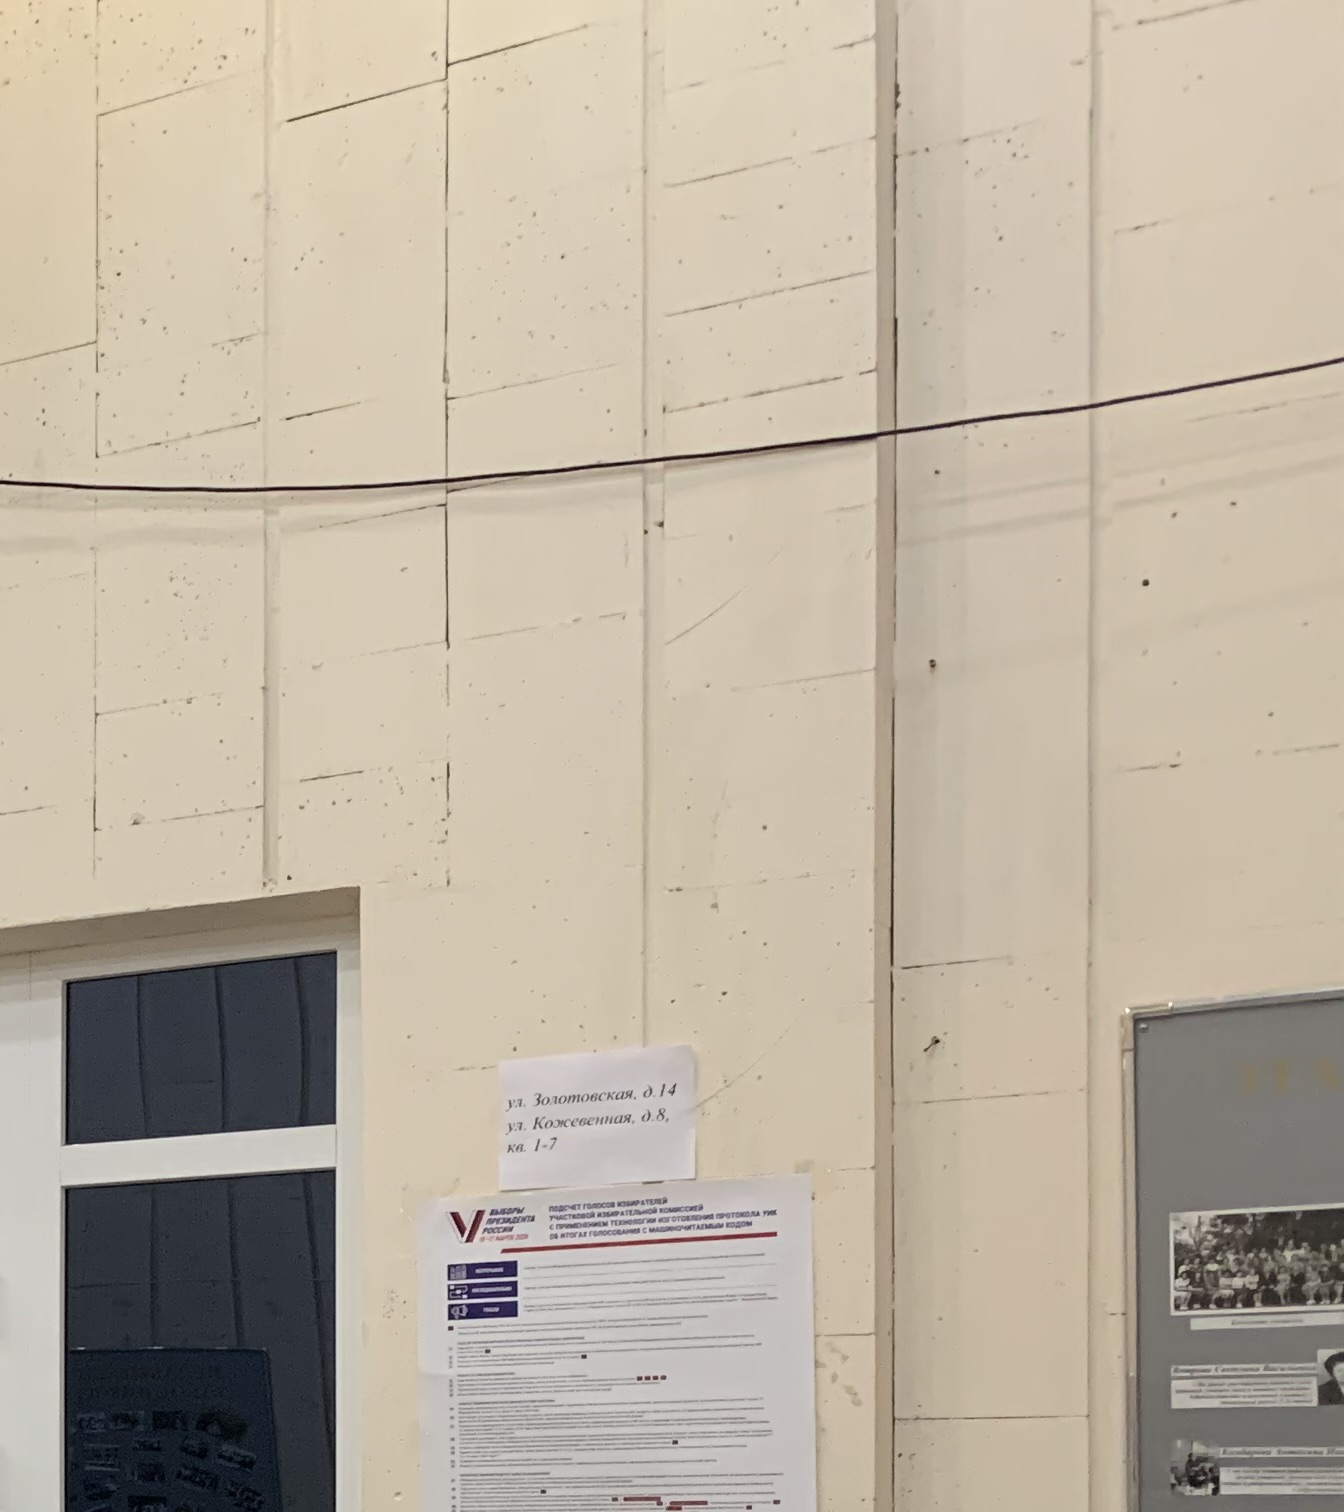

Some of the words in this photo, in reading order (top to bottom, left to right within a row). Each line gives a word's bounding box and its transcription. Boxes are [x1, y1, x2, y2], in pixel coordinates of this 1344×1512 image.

[506, 1096, 527, 1110] ул.
[533, 1086, 638, 1108] Золотовская,
[642, 1083, 677, 1099] д.14
[506, 1120, 527, 1135] ул.
[533, 1112, 636, 1132] Кожевенная,
[641, 1108, 670, 1124] д.8,
[507, 1141, 526, 1154] кв.
[534, 1138, 557, 1152] 1-7
[549, 1203, 581, 1212] ПОДСЧЕТ
[583, 1202, 616, 1211] ГОЛОСОВ
[549, 1211, 595, 1221] УЧАСТКОВОЙ
